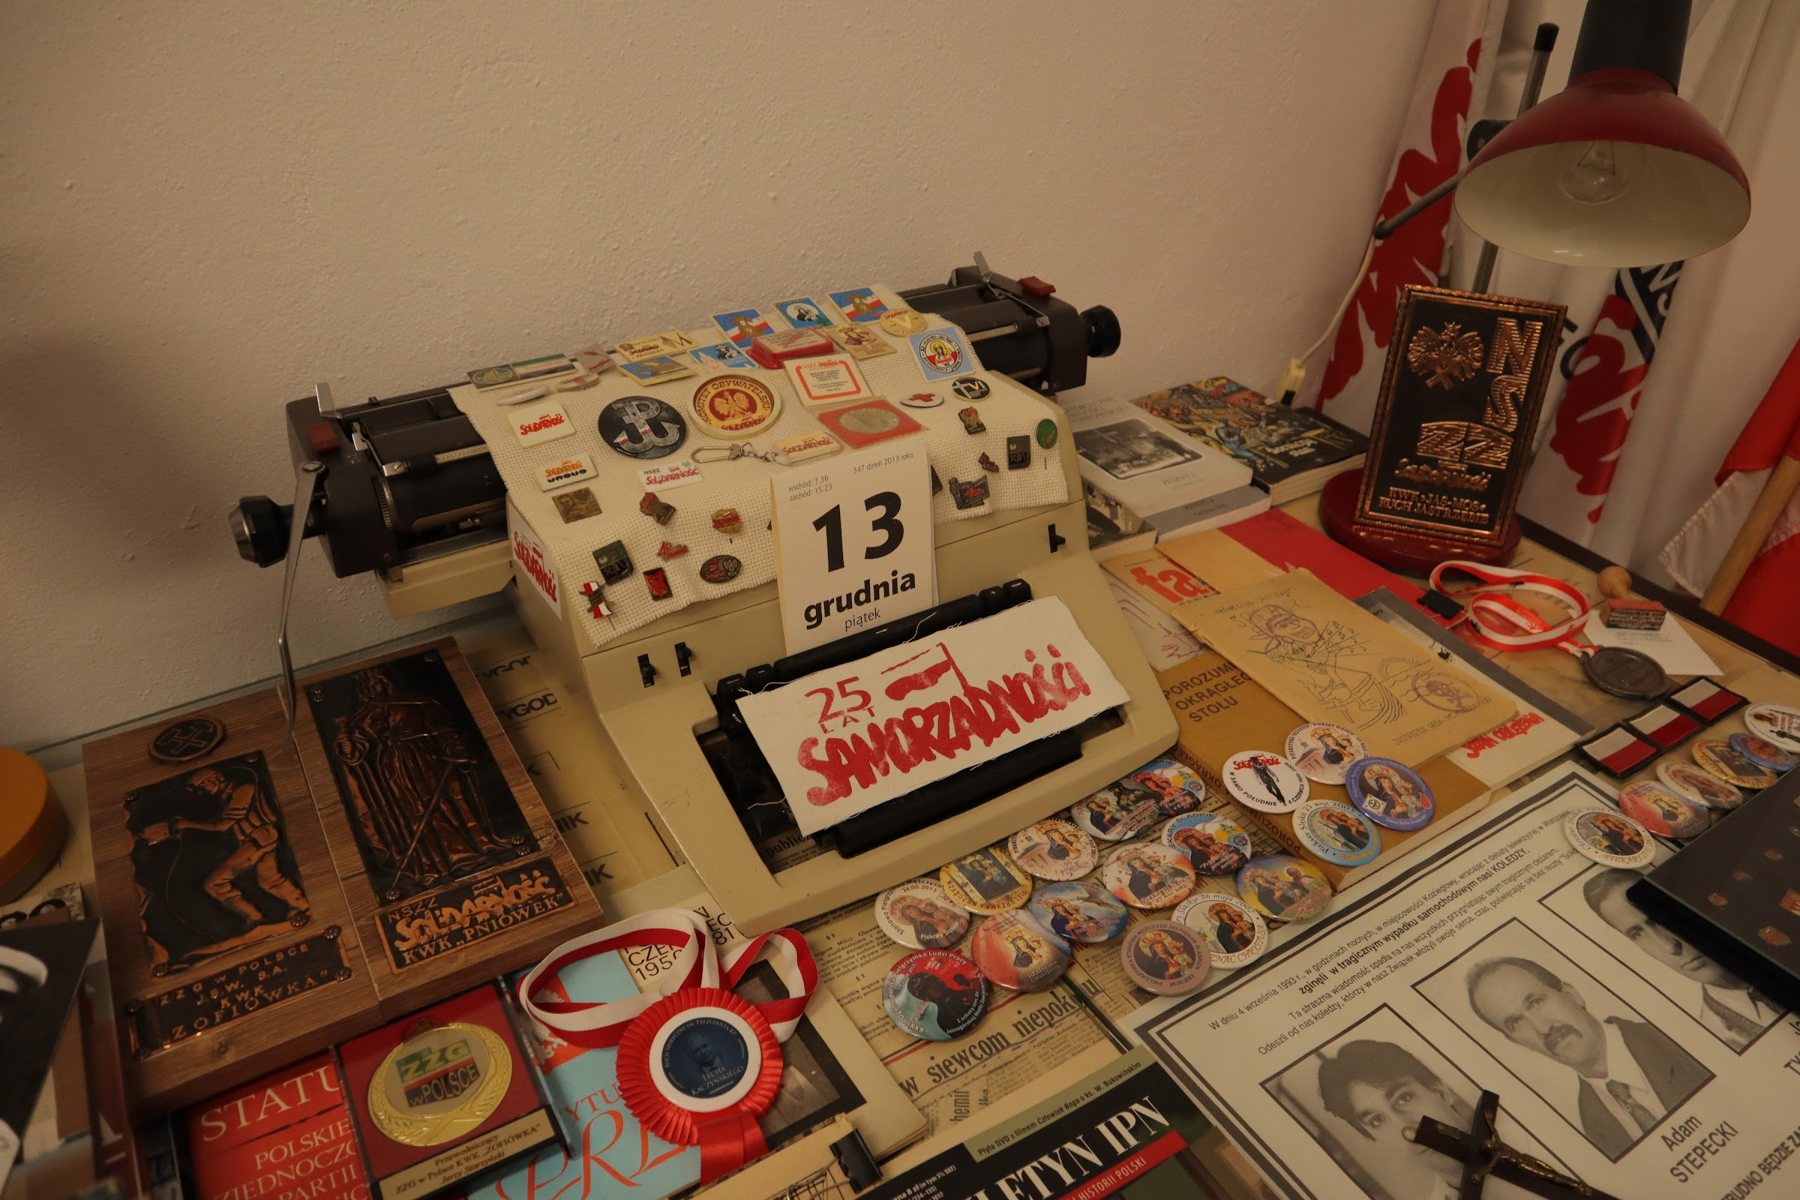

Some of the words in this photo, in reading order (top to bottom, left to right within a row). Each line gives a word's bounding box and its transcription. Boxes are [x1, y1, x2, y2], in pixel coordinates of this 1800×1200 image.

[884, 455, 900, 466] 2013
[812, 490, 905, 572] 13
[803, 569, 916, 630] grudnia
[844, 607, 881, 631] piątek
[804, 676, 873, 725] 25
[820, 705, 876, 734] LAT
[388, 898, 438, 922] NSZZ
[1298, 972, 1328, 995] zginęli
[1337, 940, 1383, 969] tragicznym
[1383, 919, 1418, 942] wypadku
[1418, 881, 1478, 921] samochodowym
[1477, 867, 1494, 882] nasi
[238, 943, 310, 976] POLSCE
[402, 942, 451, 965] KWK
[220, 985, 265, 1008] KWK
[1221, 1013, 1238, 1025] dniu
[1244, 989, 1278, 1011] września
[1277, 977, 1297, 990] 1993
[1312, 946, 1347, 971] godzinach
[1288, 1011, 1302, 1019] Ta
[1302, 993, 1332, 1013] straszna
[1331, 966, 1370, 994] wiadomość
[1258, 1033, 1288, 1054] Odeszli
[1288, 1026, 1300, 1037] od
[1299, 1016, 1314, 1030] nas
[1341, 986, 1365, 1002] którzy
[1371, 970, 1389, 983] nasz
[402, 1038, 472, 1084] ZZG
[995, 1136, 1009, 1146] DVD
[1094, 1095, 1170, 1158] IPN
[1661, 1114, 1703, 1152] Adam
[1116, 1156, 1147, 1180] POLSKI
[1669, 1120, 1740, 1183] STEPECKI
[1757, 1140, 1791, 1176] BĘDZIE
